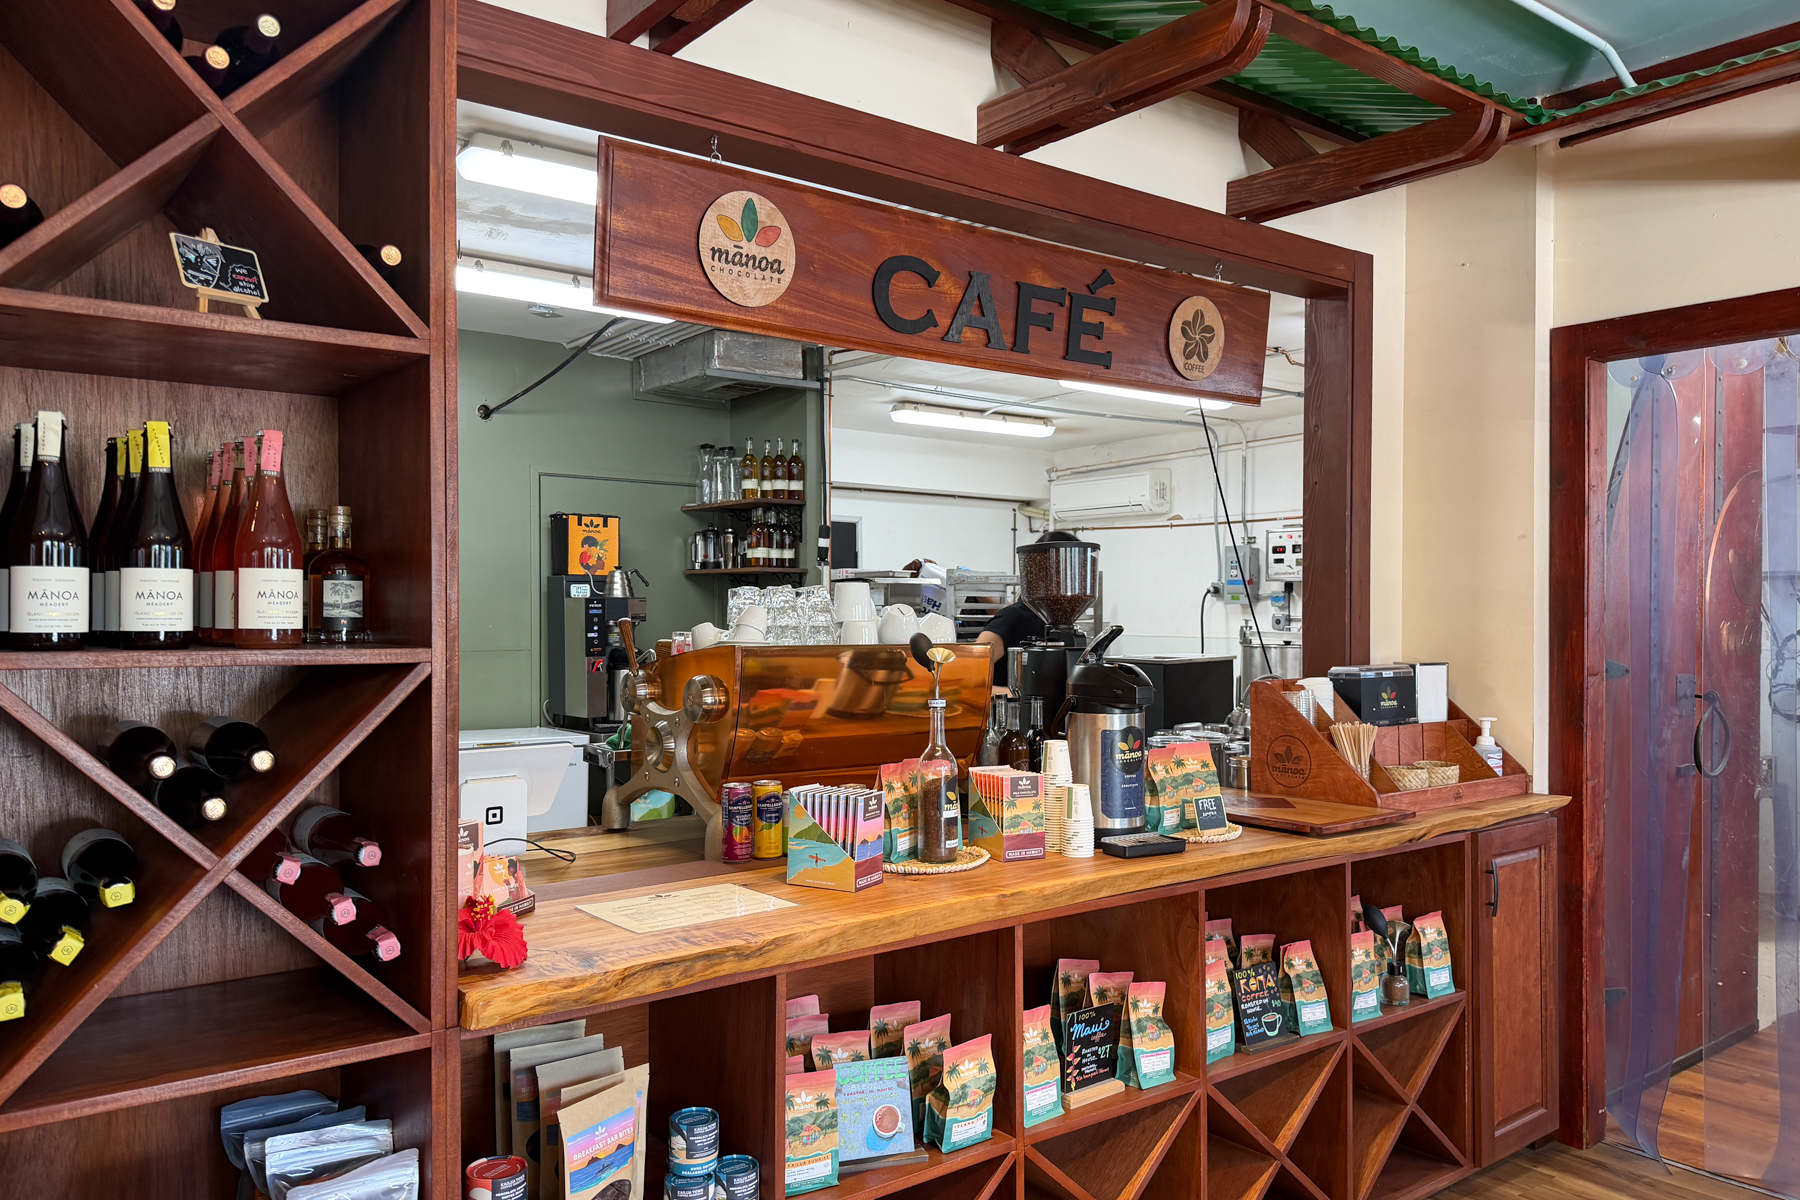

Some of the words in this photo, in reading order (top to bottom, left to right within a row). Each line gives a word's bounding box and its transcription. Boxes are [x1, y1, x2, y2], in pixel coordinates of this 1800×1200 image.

[710, 245, 785, 275] mānoa
[711, 266, 781, 284] CHOCOLATE
[232, 286, 261, 296] alcohol
[872, 254, 1116, 370] CAFÉ
[1184, 363, 1205, 374] COFFEE
[27, 589, 80, 600] MĀNOA
[135, 590, 184, 600] MĀNOA
[256, 588, 300, 600] MĀNOA
[1116, 750, 1142, 760] mānoa
[1272, 764, 1306, 776] mānoa
[1198, 798, 1217, 810] FREE
[1235, 968, 1256, 980] 100%
[1239, 974, 1276, 994] KONA
[1241, 990, 1270, 1002] COFFEE
[1240, 1000, 1262, 1010] ROASTED
[1078, 1011, 1096, 1021] 100%
[1070, 1017, 1110, 1040] Maui
[1098, 1044, 1113, 1058] $27
[838, 1058, 907, 1086] COFFEE
[872, 1092, 900, 1104] prices
[840, 1110, 860, 1126] $12
[573, 1140, 606, 1161] BREAKFAST
[606, 1136, 618, 1144] BAR
[619, 1126, 634, 1140] BITES
[808, 1156, 829, 1164] SUNRISE
